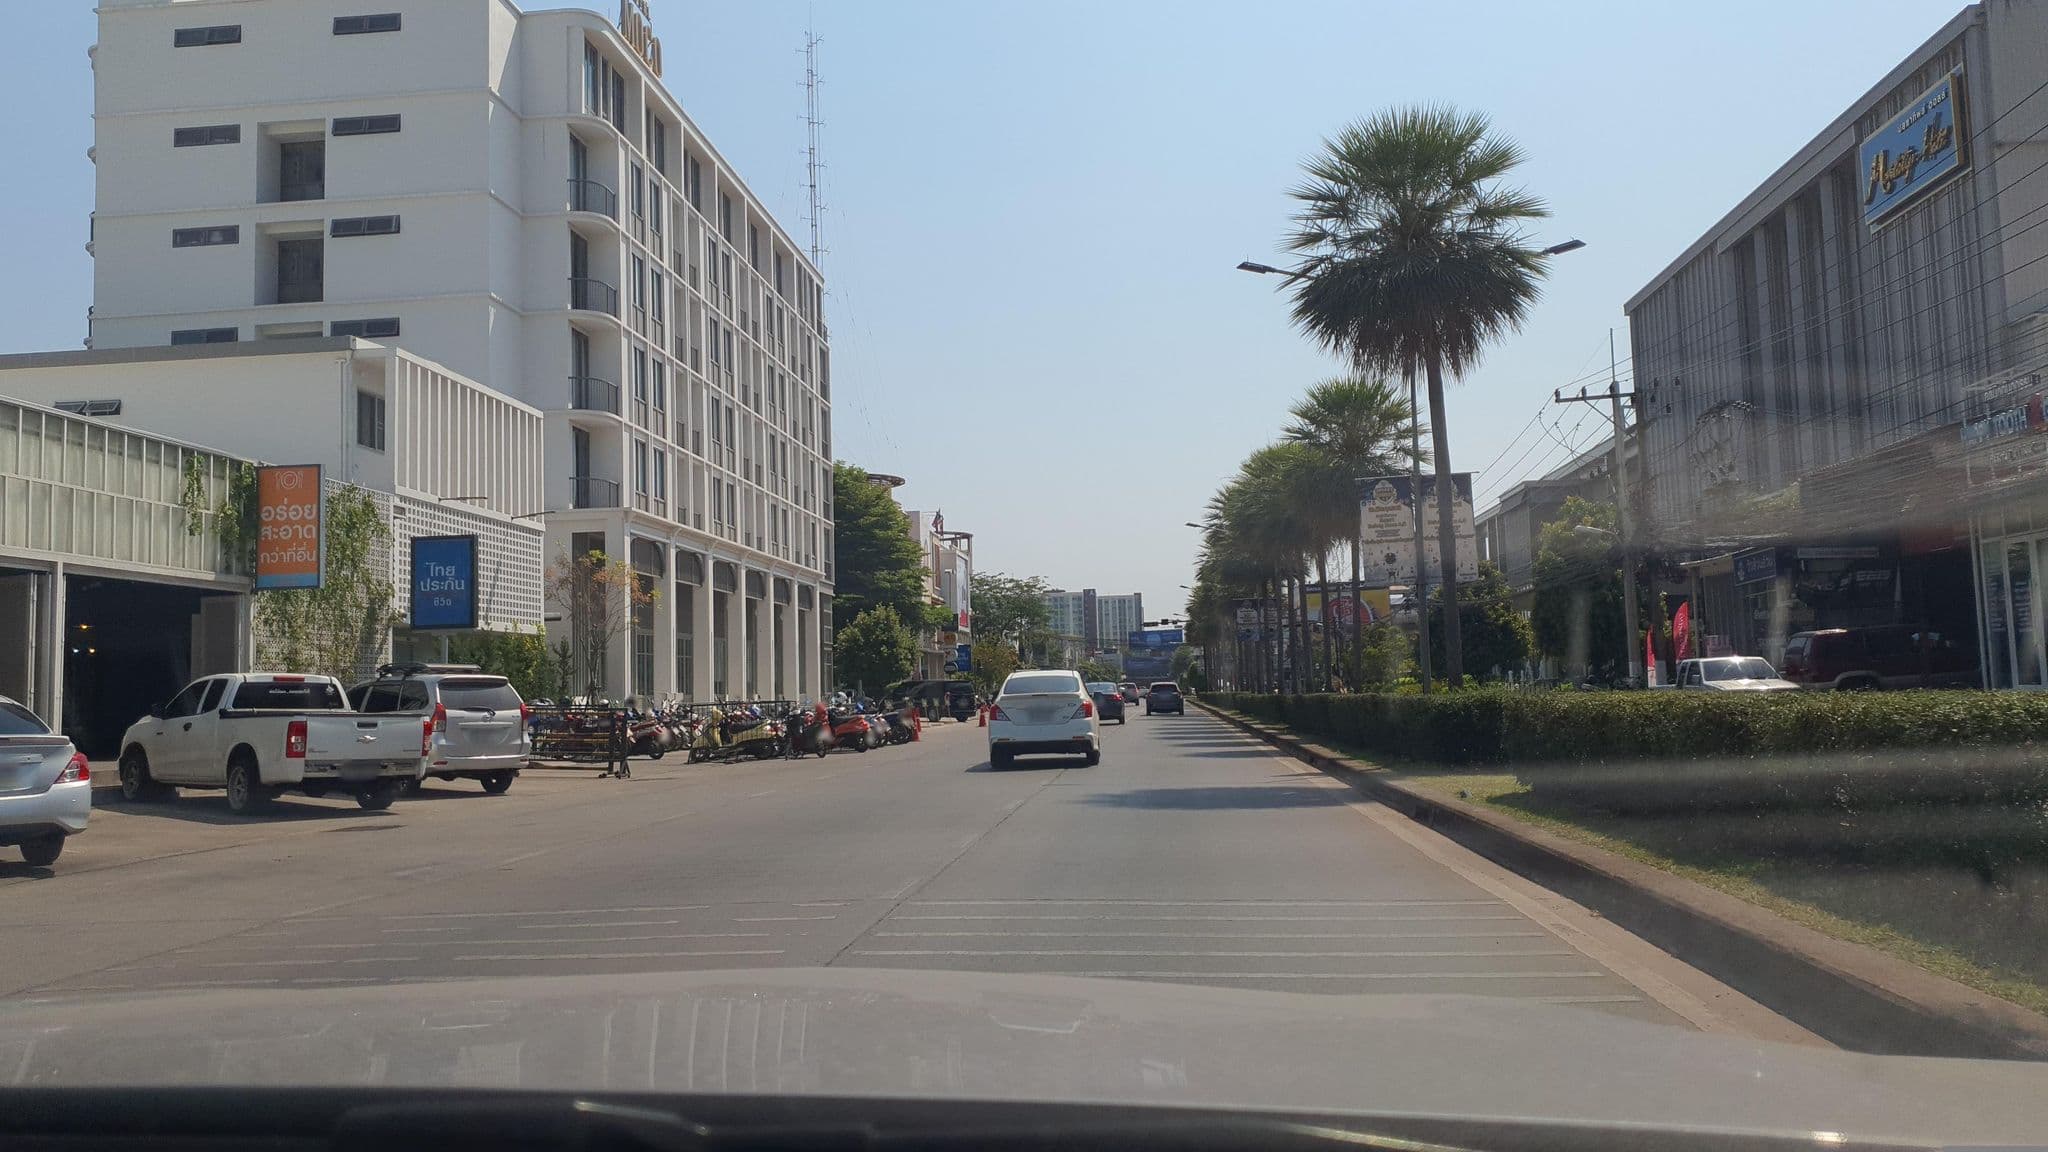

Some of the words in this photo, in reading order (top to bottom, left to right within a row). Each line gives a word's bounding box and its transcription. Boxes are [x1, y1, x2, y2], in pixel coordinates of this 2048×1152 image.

[260, 498, 317, 521] อร่อย
[260, 524, 317, 541] สะอาด
[260, 542, 317, 563] กว่าที่อื่น
[424, 562, 456, 577] ไทย
[420, 577, 465, 592] ประกัน
